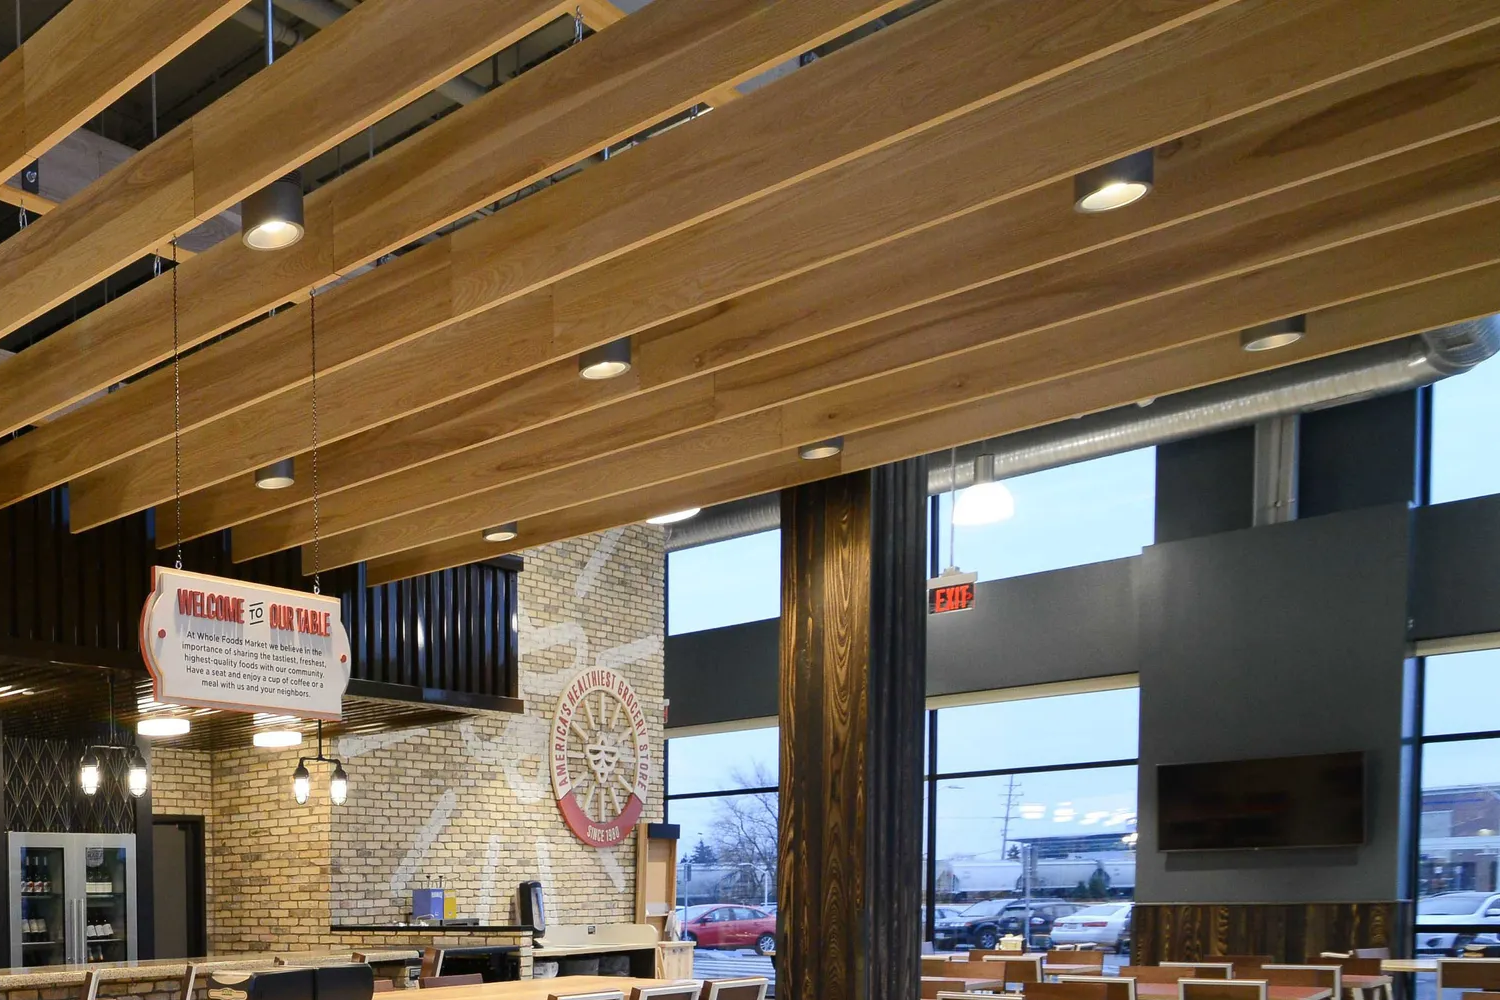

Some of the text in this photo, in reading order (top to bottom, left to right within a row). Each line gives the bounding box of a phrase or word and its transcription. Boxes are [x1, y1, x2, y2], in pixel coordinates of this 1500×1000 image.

[935, 585, 969, 613] EXIT
[177, 588, 330, 637] WELCOME TO OUR TABLE
[182, 643, 326, 668] importance of sharing the tastiest, freshest,
[187, 631, 195, 639] At
[197, 632, 219, 642] Whole
[222, 635, 243, 645] Foods
[245, 639, 267, 649] Market
[280, 644, 303, 653] believe
[312, 648, 322, 656] the
[185, 654, 237, 668] highest-quality
[239, 660, 258, 669] foods
[260, 663, 274, 671] with
[287, 667, 324, 679] community.
[187, 666, 203, 675] Have
[212, 669, 226, 677] seat
[228, 670, 241, 679] and
[243, 673, 261, 682] enjoy
[268, 676, 280, 684] cup
[282, 676, 288, 684] of
[291, 677, 309, 687] coffee
[202, 679, 218, 687] meal
[220, 681, 235, 689] with
[246, 684, 258, 692] and
[261, 686, 275, 694] your
[277, 686, 310, 697] neighbors.
[556, 670, 648, 790] AMERICA'S HEALTHIEST GROCERY STORE
[587, 824, 620, 842] SINCE 1980
